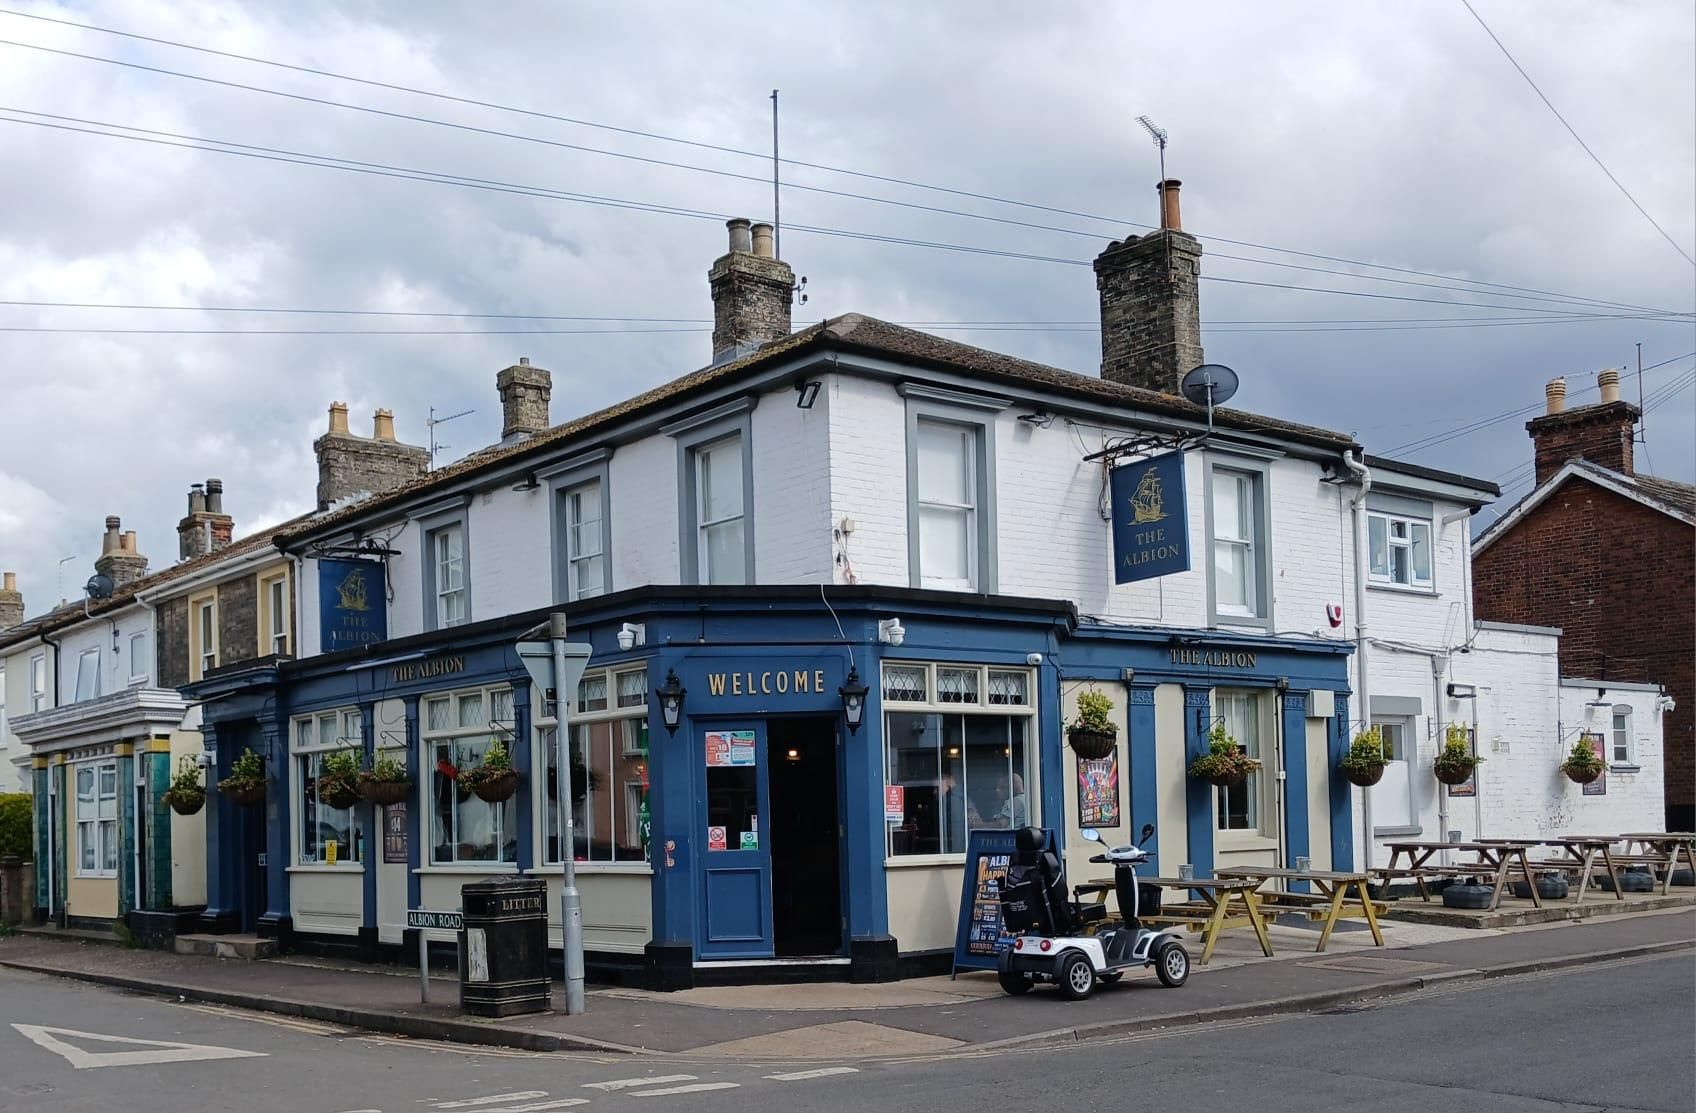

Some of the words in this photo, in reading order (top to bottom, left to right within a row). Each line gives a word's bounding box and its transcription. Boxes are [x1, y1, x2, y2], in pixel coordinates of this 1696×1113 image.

[1135, 528, 1166, 546] THE
[1123, 543, 1179, 568] ALBION
[341, 615, 369, 627] THE
[328, 630, 380, 641] ALBION
[1169, 648, 1201, 664] THE
[1203, 650, 1257, 668] ALBION
[391, 664, 417, 682] THE
[418, 656, 465, 678] ALBION
[708, 670, 825, 696] WELCOME
[989, 855, 1010, 867] ALBI
[502, 897, 541, 911] LITTER
[408, 912, 436, 928] ALBION
[439, 914, 462, 929] ROAD
